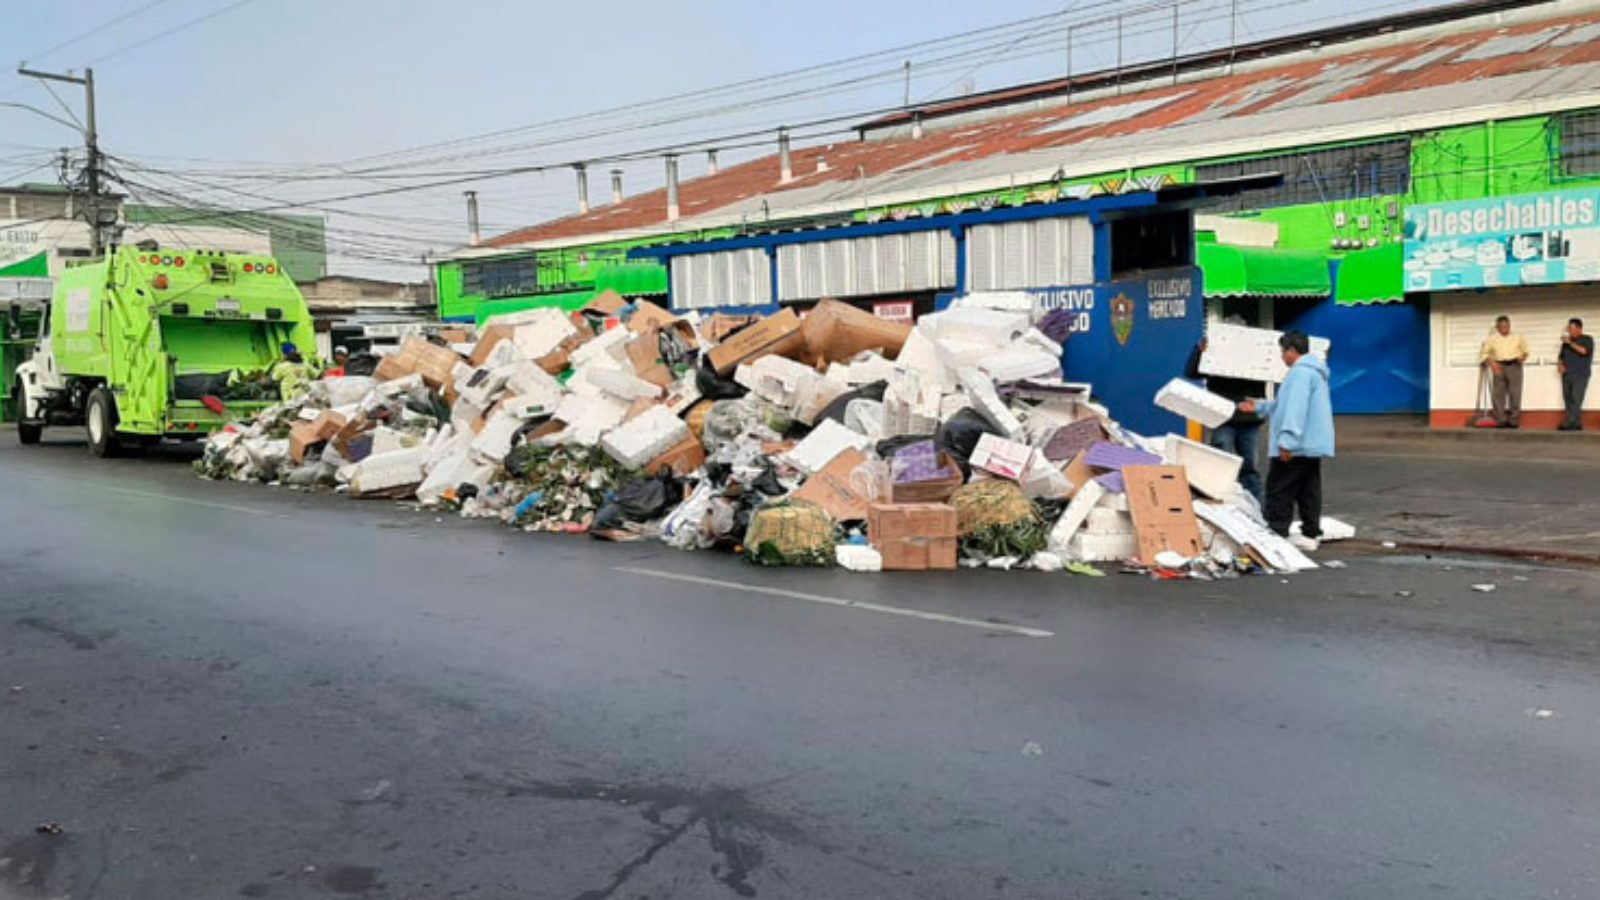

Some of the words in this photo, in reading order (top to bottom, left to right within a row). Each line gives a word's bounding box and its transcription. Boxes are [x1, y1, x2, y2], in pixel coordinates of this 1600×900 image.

[1428, 195, 1593, 237] Desechables
[1147, 278, 1192, 298] EXCLUSIVO
[1148, 299, 1186, 319] MERCADO
